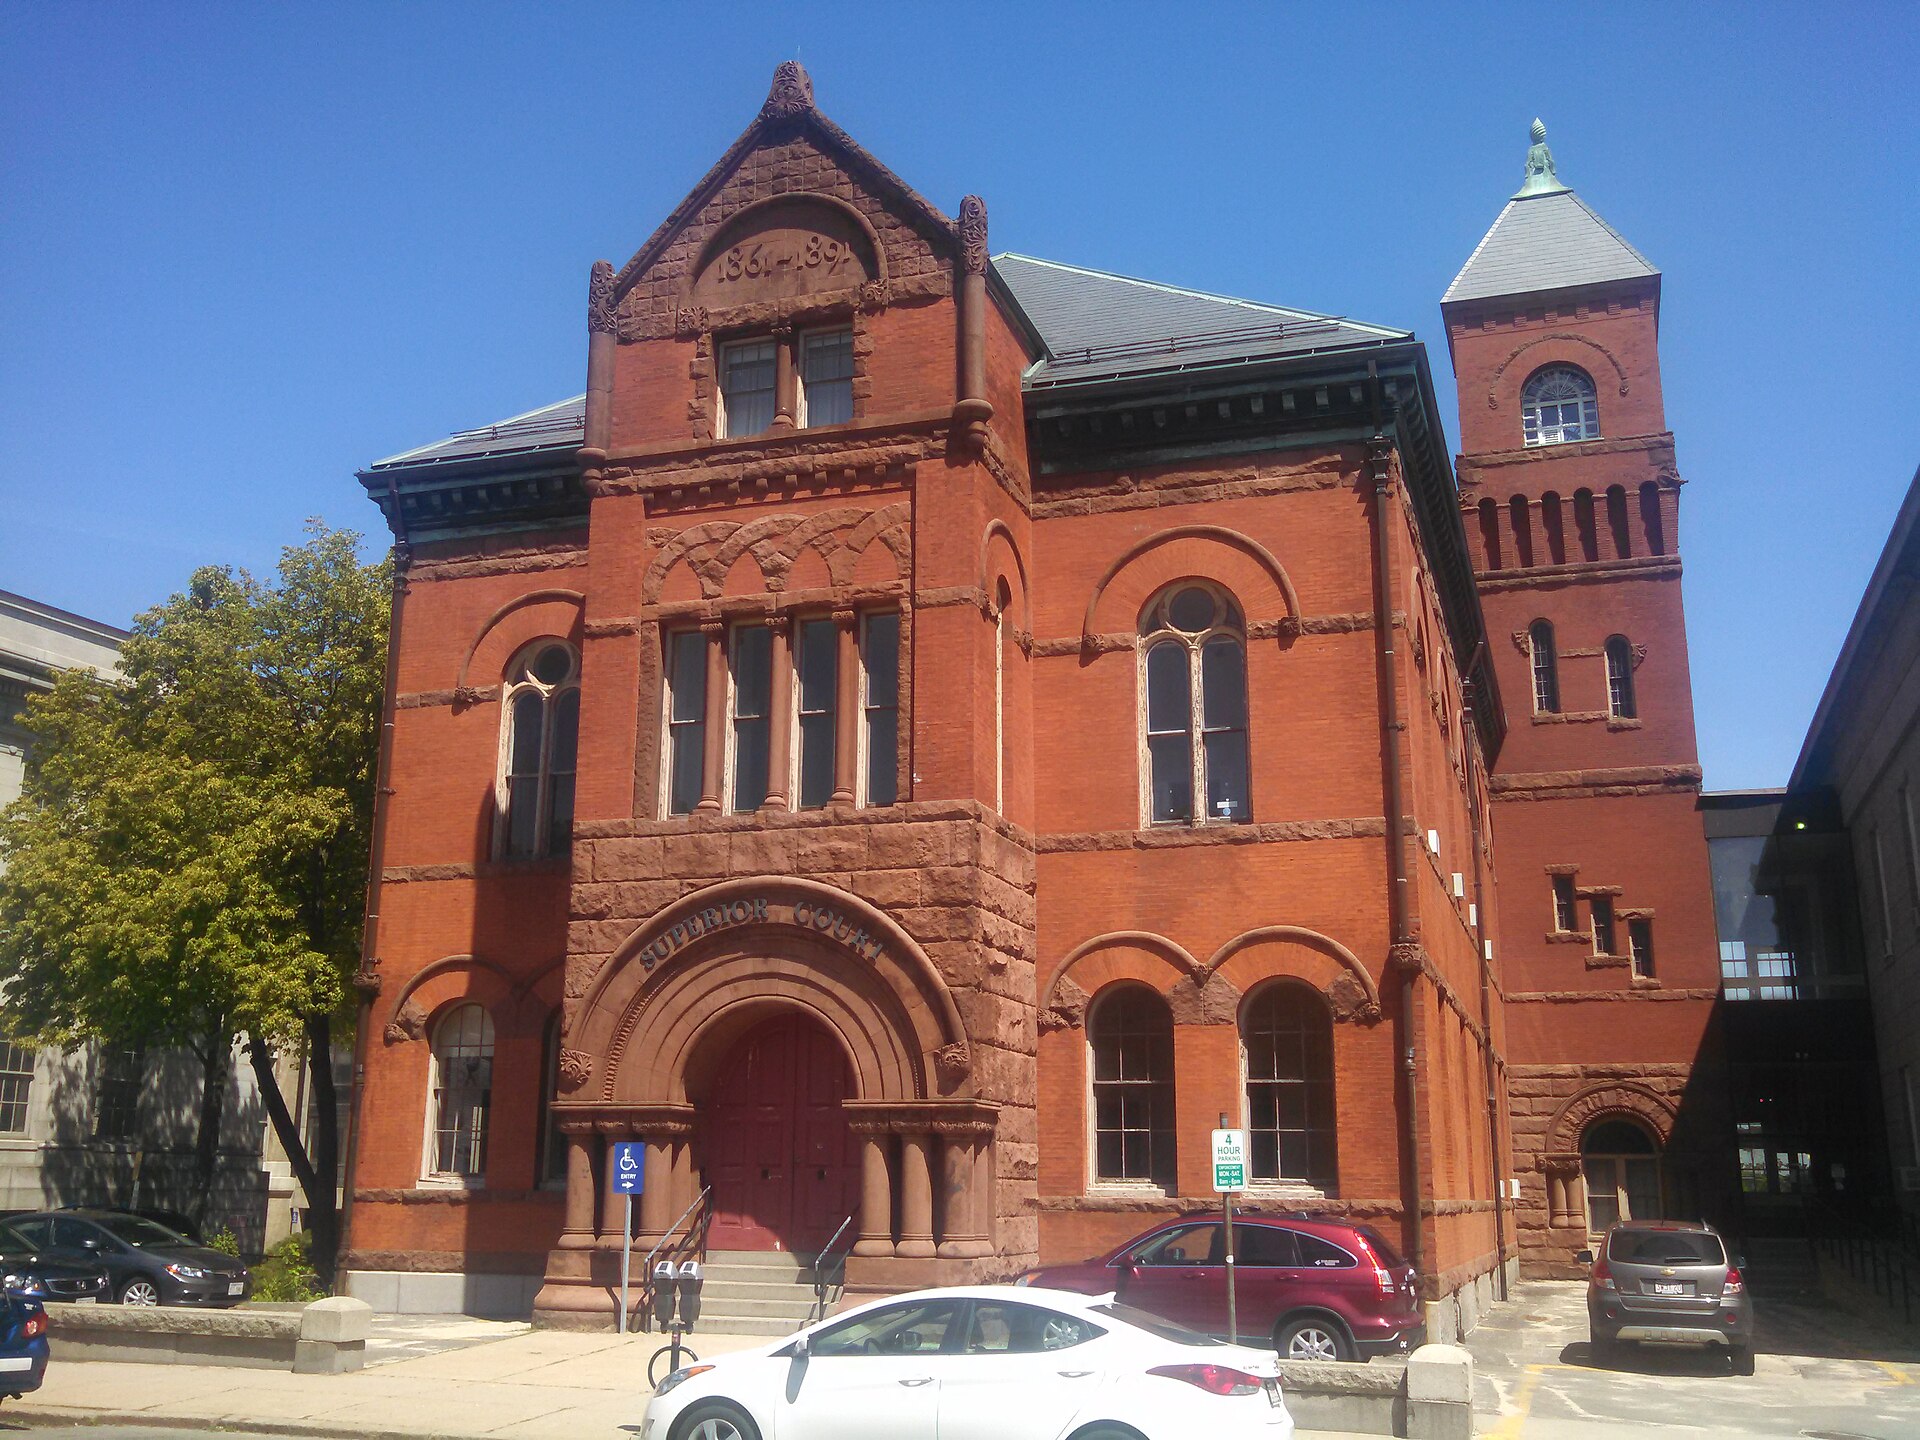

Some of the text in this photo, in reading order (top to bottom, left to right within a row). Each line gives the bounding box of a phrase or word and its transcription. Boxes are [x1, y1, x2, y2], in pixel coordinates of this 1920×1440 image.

[640, 898, 884, 967] SUPERIOR COURT
[1225, 1133, 1232, 1145] 4
[1217, 1146, 1241, 1154] HOUR
